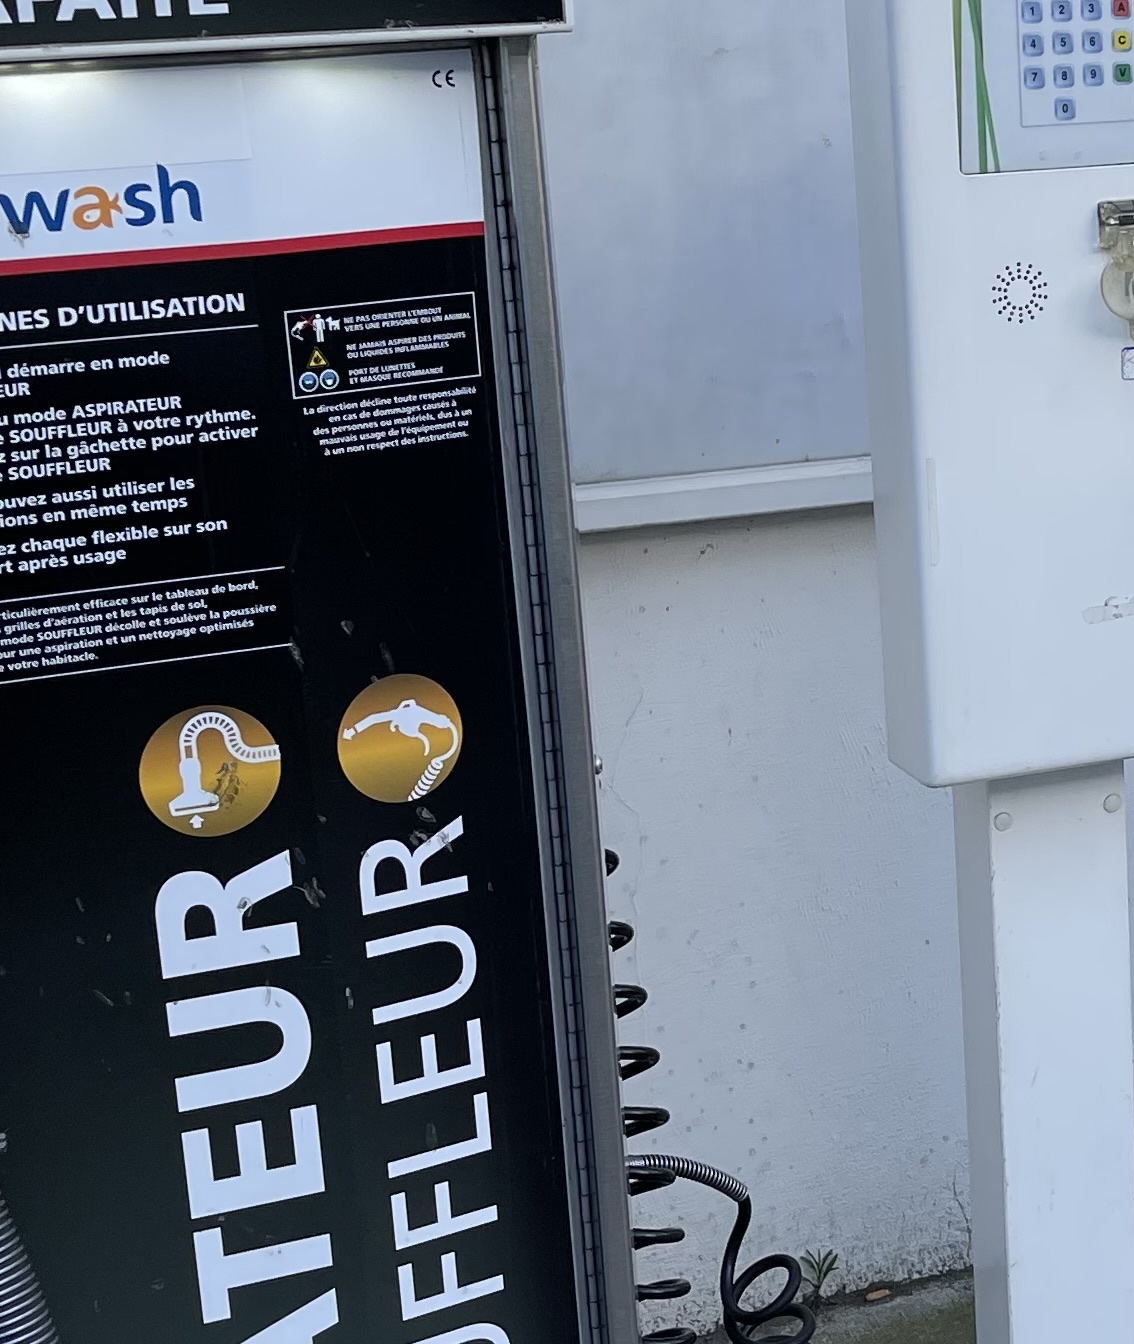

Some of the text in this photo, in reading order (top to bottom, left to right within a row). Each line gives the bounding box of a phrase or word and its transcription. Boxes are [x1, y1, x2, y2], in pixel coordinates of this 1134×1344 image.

[1030, 6, 1034, 15] 1
[1059, 5, 1065, 14] 2
[1088, 3, 1094, 13] 3
[1118, 2, 1125, 11] A
[1030, 39, 1036, 48] 4
[1061, 37, 1066, 47] 5
[1090, 37, 1095, 46] 6
[1119, 36, 1126, 44] C
[1032, 72, 1037, 81] 7
[1062, 71, 1067, 80] 8
[1091, 69, 1096, 78] 9
[1119, 68, 1126, 77] V
[1062, 104, 1068, 113] 0
[0, 164, 202, 232] wash
[57, 292, 244, 326] D'UTILISATION
[8, 350, 169, 378] démarre en mode
[13, 395, 181, 424] mode ASPIRATEUR
[9, 409, 255, 443] SOUFFLEUR à votre rythme.
[10, 425, 258, 461] sur la gâchette pour activer
[8, 457, 110, 480] SOUFFLEUR
[52, 485, 96, 503] aussi
[102, 480, 164, 498] utiliser
[170, 477, 194, 490] les
[42, 497, 187, 522] en même temps
[21, 519, 227, 552] chaque flexible sur son
[18, 549, 126, 573] après usage
